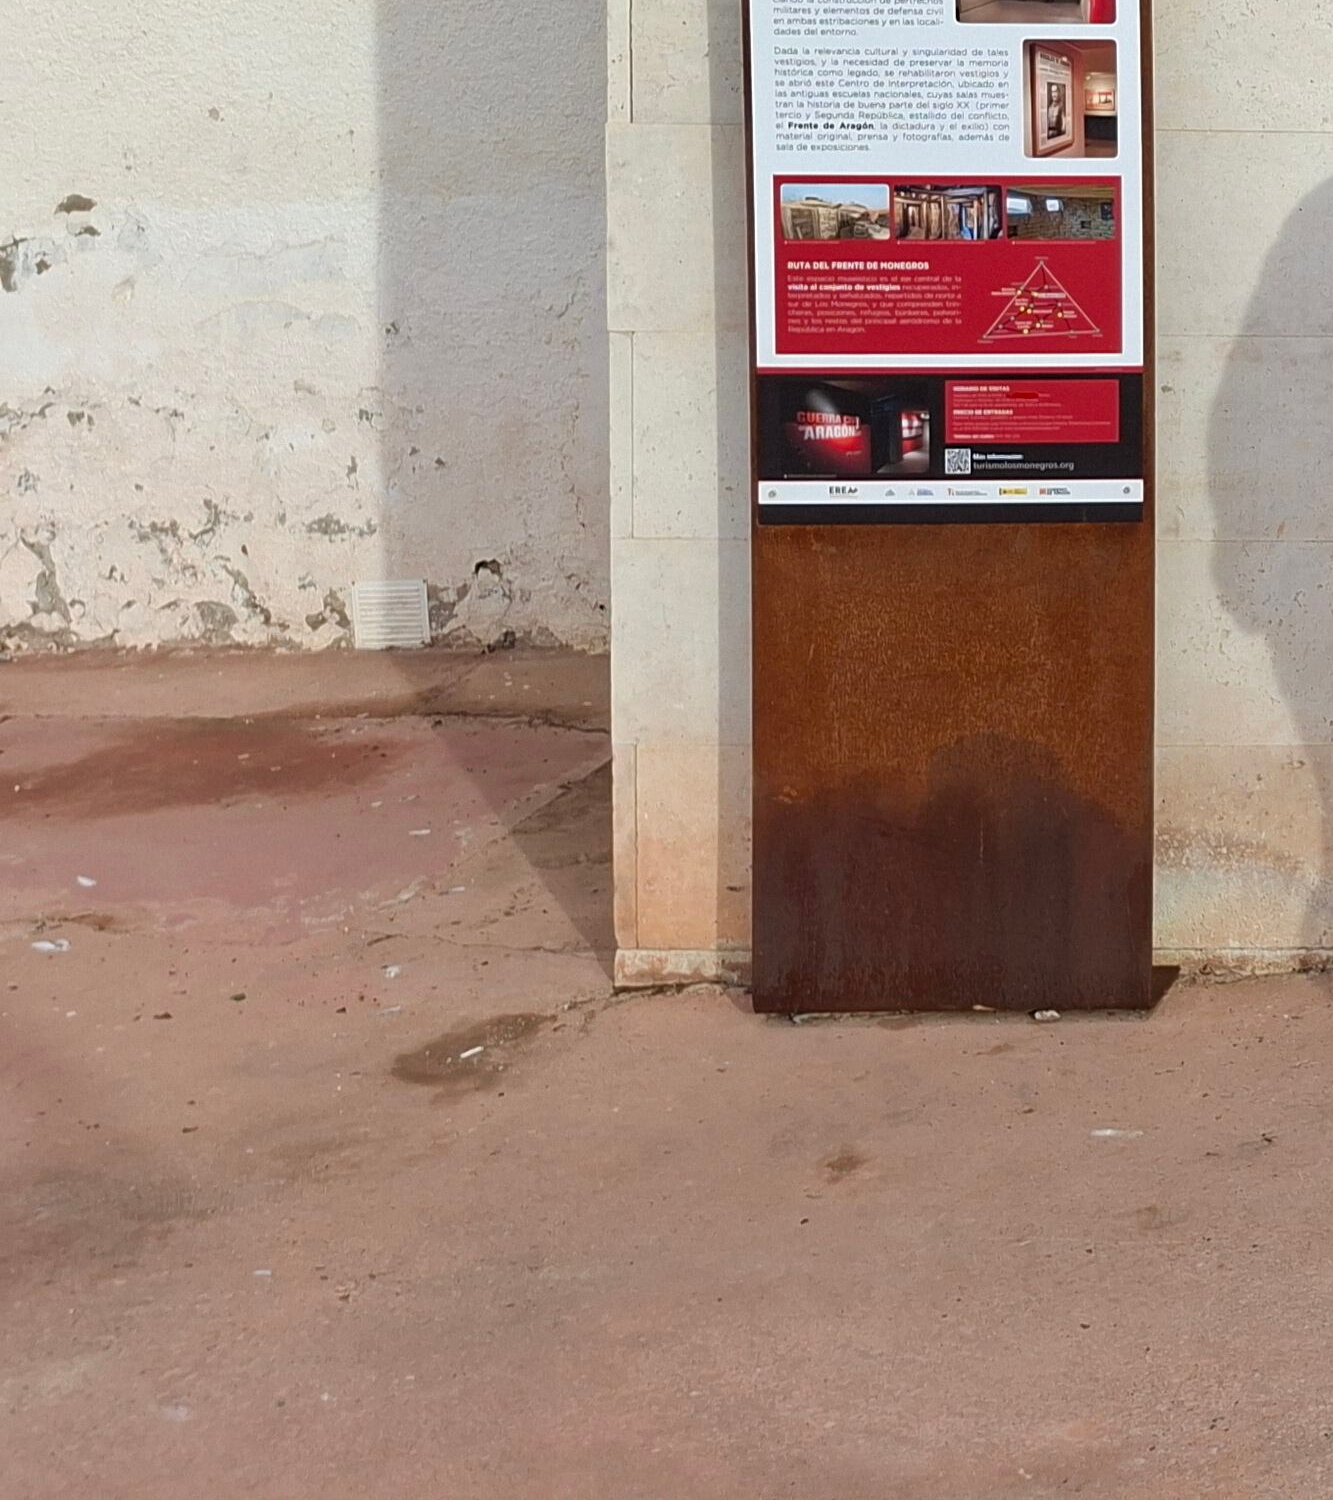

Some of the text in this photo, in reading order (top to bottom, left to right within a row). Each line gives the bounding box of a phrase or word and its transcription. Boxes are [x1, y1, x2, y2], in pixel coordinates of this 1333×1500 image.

[773, 6, 943, 16] militares y elementos de defensa civil
[787, 17, 817, 25] ambas
[819, 17, 880, 25] estribaciones
[881, 19, 887, 27] y
[902, 18, 915, 26] las
[917, 18, 943, 26] locali-
[774, 28, 801, 36] dades
[804, 28, 818, 36] del
[774, 47, 1008, 58] Dada la relevancia cultural y singularidad de tales
[821, 60, 827, 68] y
[831, 58, 839, 66] la
[843, 58, 889, 66] necesidad
[893, 58, 905, 66] de
[957, 59, 965, 67] la
[969, 59, 1008, 67] memoria
[788, 79, 812, 87] abrió
[815, 79, 835, 87] este
[838, 79, 870, 87] Centro
[873, 79, 885, 87] de
[957, 80, 995, 88] ubicado
[775, 121, 784, 129] el
[788, 121, 819, 129] Frente
[823, 122, 835, 130] de
[880, 122, 888, 130] la
[892, 122, 936, 130] dictadura
[939, 124, 945, 132] y
[949, 122, 957, 130] el
[961, 122, 989, 132] exilio)
[776, 142, 794, 150] sala
[797, 143, 808, 151] de
[787, 261, 929, 270] RUTA DEL FRENTE DE MONEGROS
[973, 461, 1074, 470] turismolosmonegros.org
